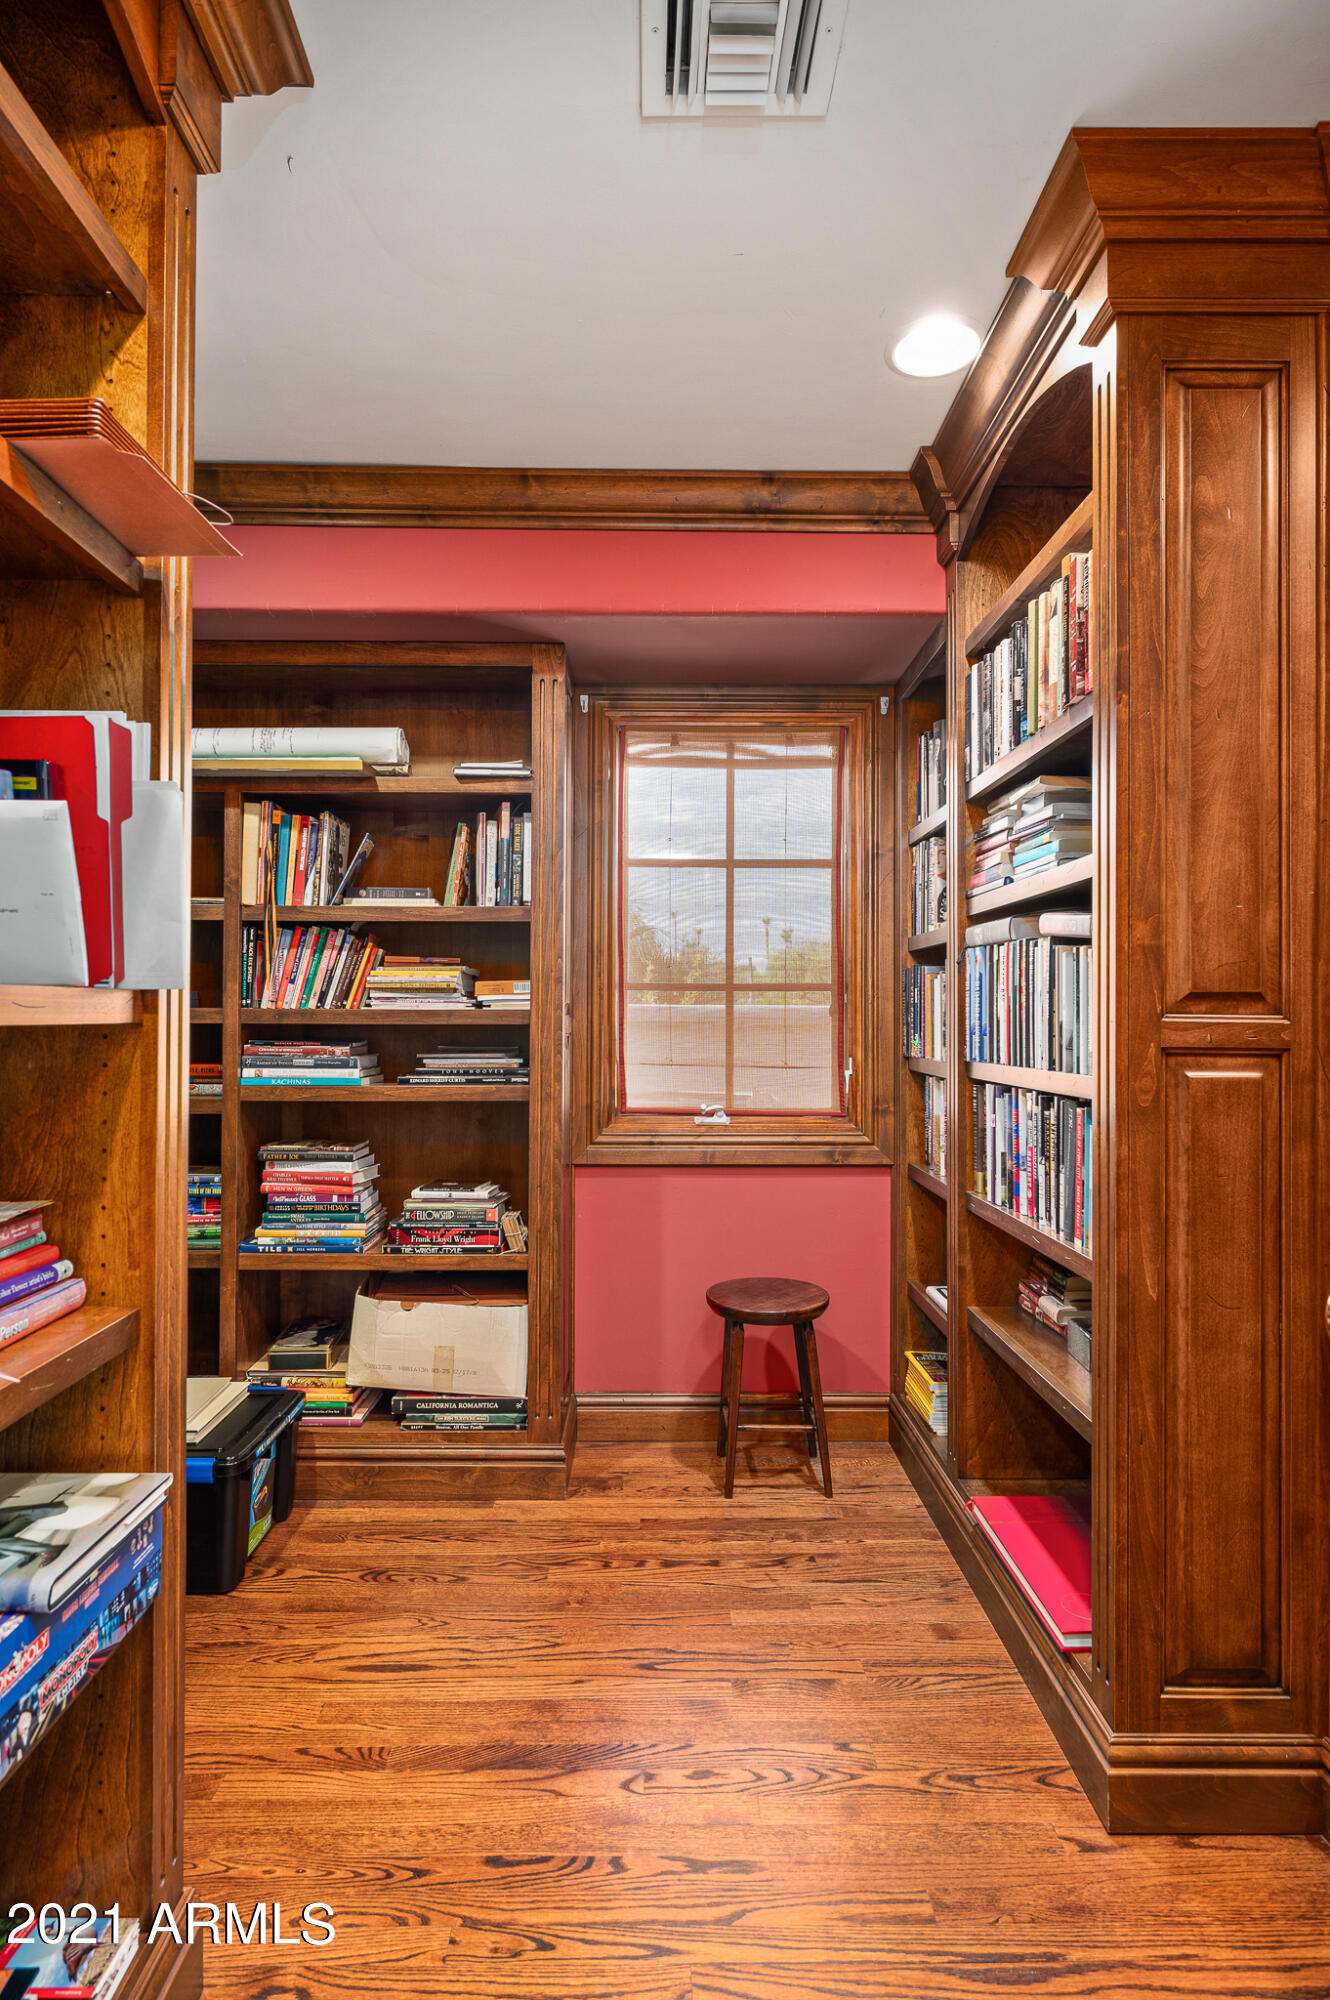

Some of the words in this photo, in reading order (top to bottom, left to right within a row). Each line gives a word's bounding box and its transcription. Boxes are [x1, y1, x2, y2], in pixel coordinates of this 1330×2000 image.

[299, 1194, 316, 1202] GLASS
[411, 1235, 433, 1243] Frank
[433, 1235, 452, 1245] Lloyd
[454, 1235, 476, 1246] Wright
[41, 1637, 96, 1704] MONOPOLY
[56, 1662, 88, 1705] EMPIRE
